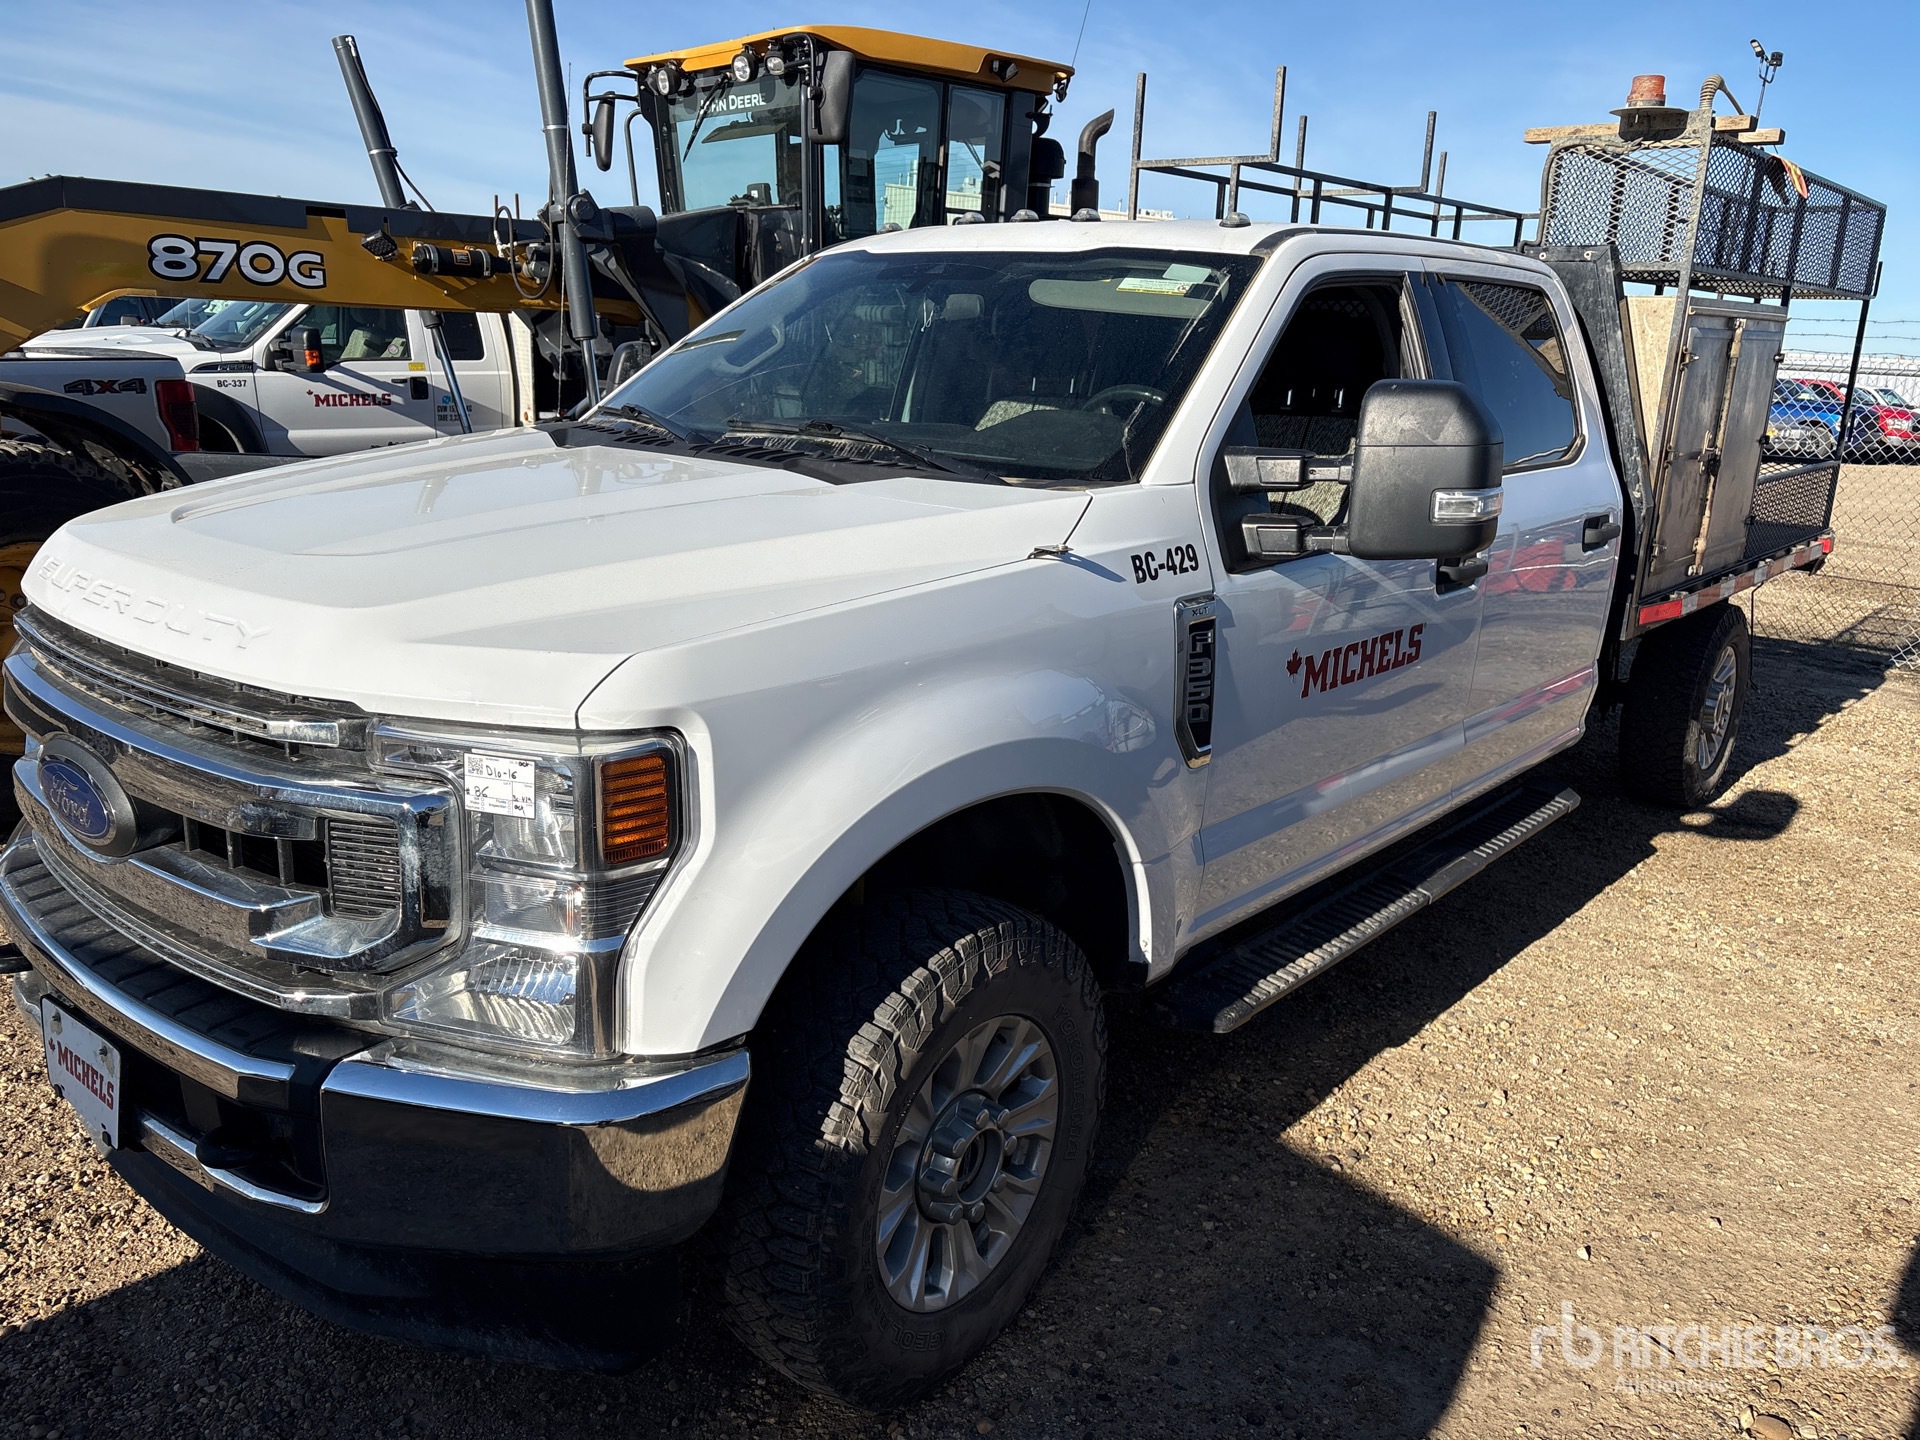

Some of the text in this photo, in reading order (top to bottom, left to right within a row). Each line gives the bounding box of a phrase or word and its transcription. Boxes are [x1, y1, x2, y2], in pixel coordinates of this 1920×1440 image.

[728, 92, 767, 110] DEERE
[147, 234, 327, 289] 870G
[216, 379, 247, 388] BC-337
[314, 392, 392, 408] MICHELS
[1130, 543, 1200, 584] BC-429
[37, 554, 274, 650] SUPER DUTY
[1191, 606, 1210, 617] XLT
[1301, 622, 1425, 699] MICHELS
[49, 770, 92, 828] Ford
[57, 1040, 114, 1110] MICHELS
[1052, 1003, 1087, 1161] YOKOHAMA
